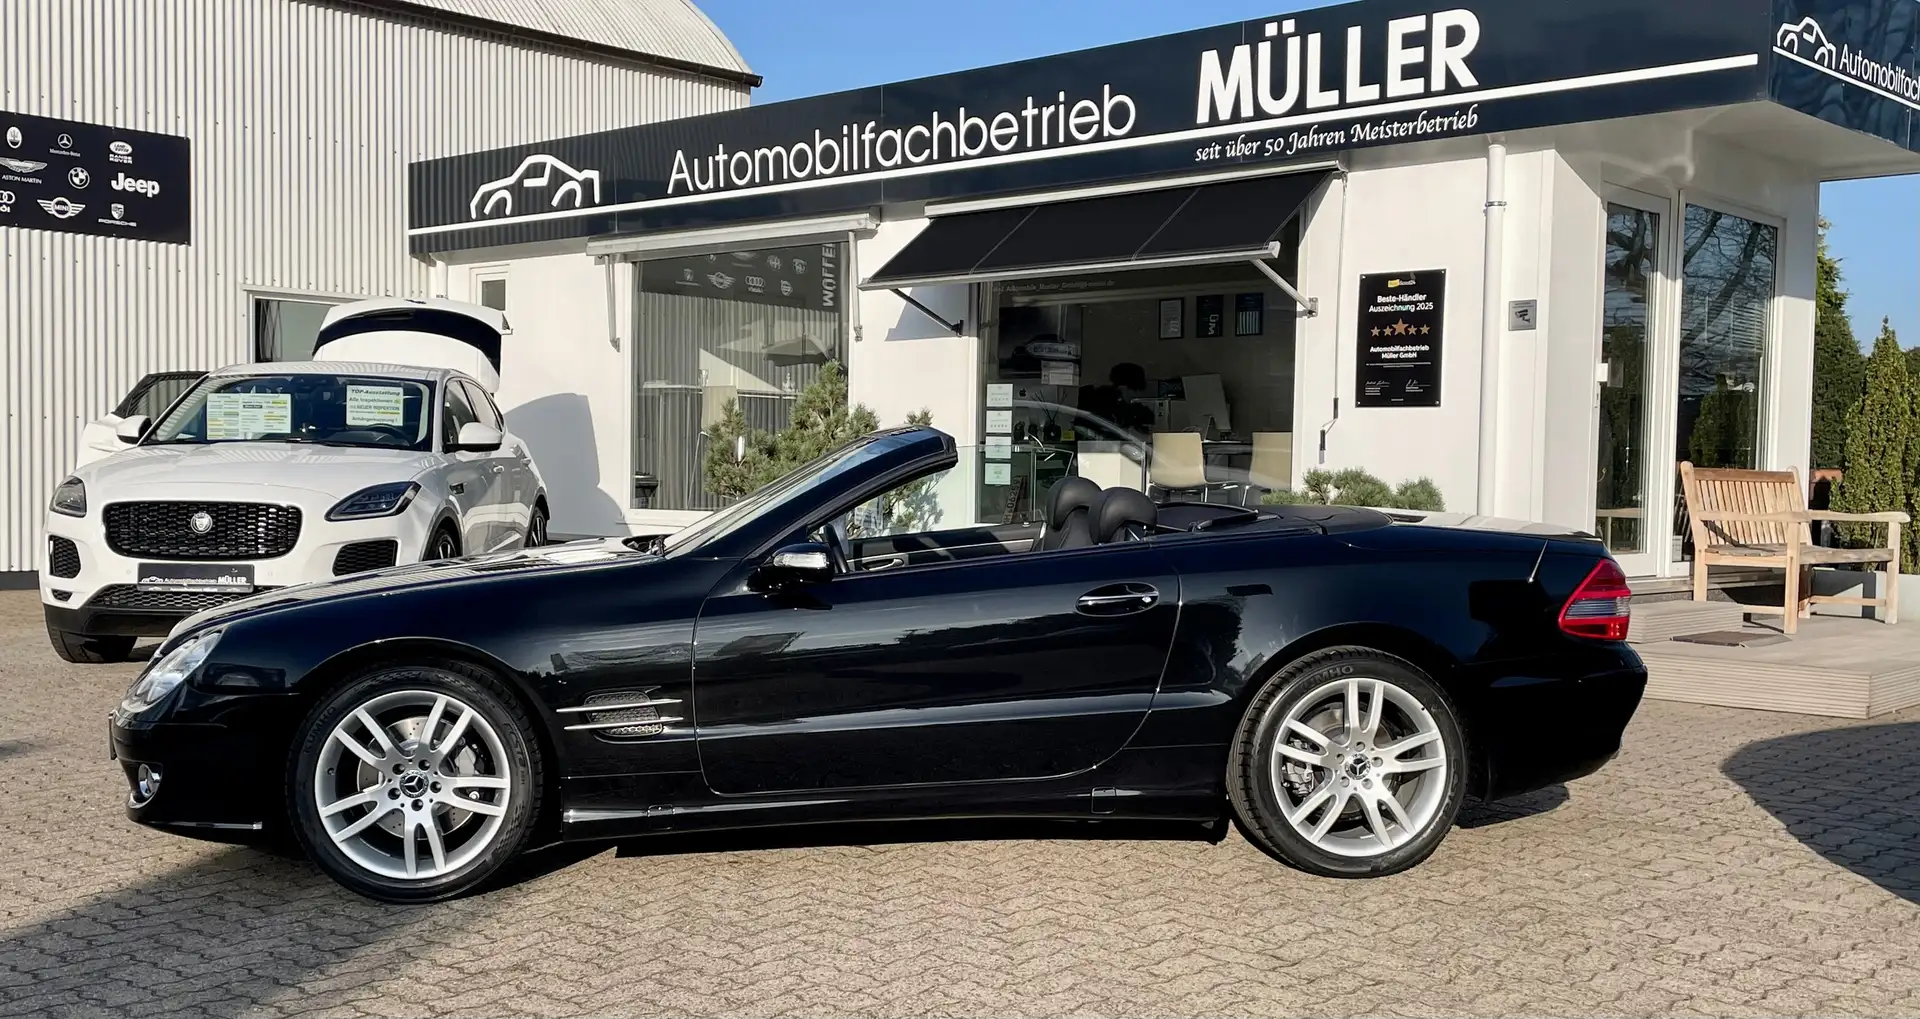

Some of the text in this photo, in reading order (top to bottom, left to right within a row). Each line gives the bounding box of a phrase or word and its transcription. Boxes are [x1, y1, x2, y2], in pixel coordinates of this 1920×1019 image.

[1196, 9, 1480, 124] MÜLLER
[1839, 43, 1920, 101] Automobilfac
[1195, 104, 1479, 161] seit über 50 Jahren Meisterbetrieb
[667, 84, 1136, 194] Automobilfachbetrieb
[1, 174, 42, 185] ASTON MARTIN
[110, 172, 160, 198] Jeep
[54, 204, 70, 212] MINI
[1377, 294, 1427, 303] Beste-Händler
[1369, 302, 1434, 313] Auszeichnung 2025
[1370, 345, 1430, 353] Automobilfachbetrieb
[1399, 351, 1417, 359] GmbH
[217, 575, 247, 584] MÜLLER
